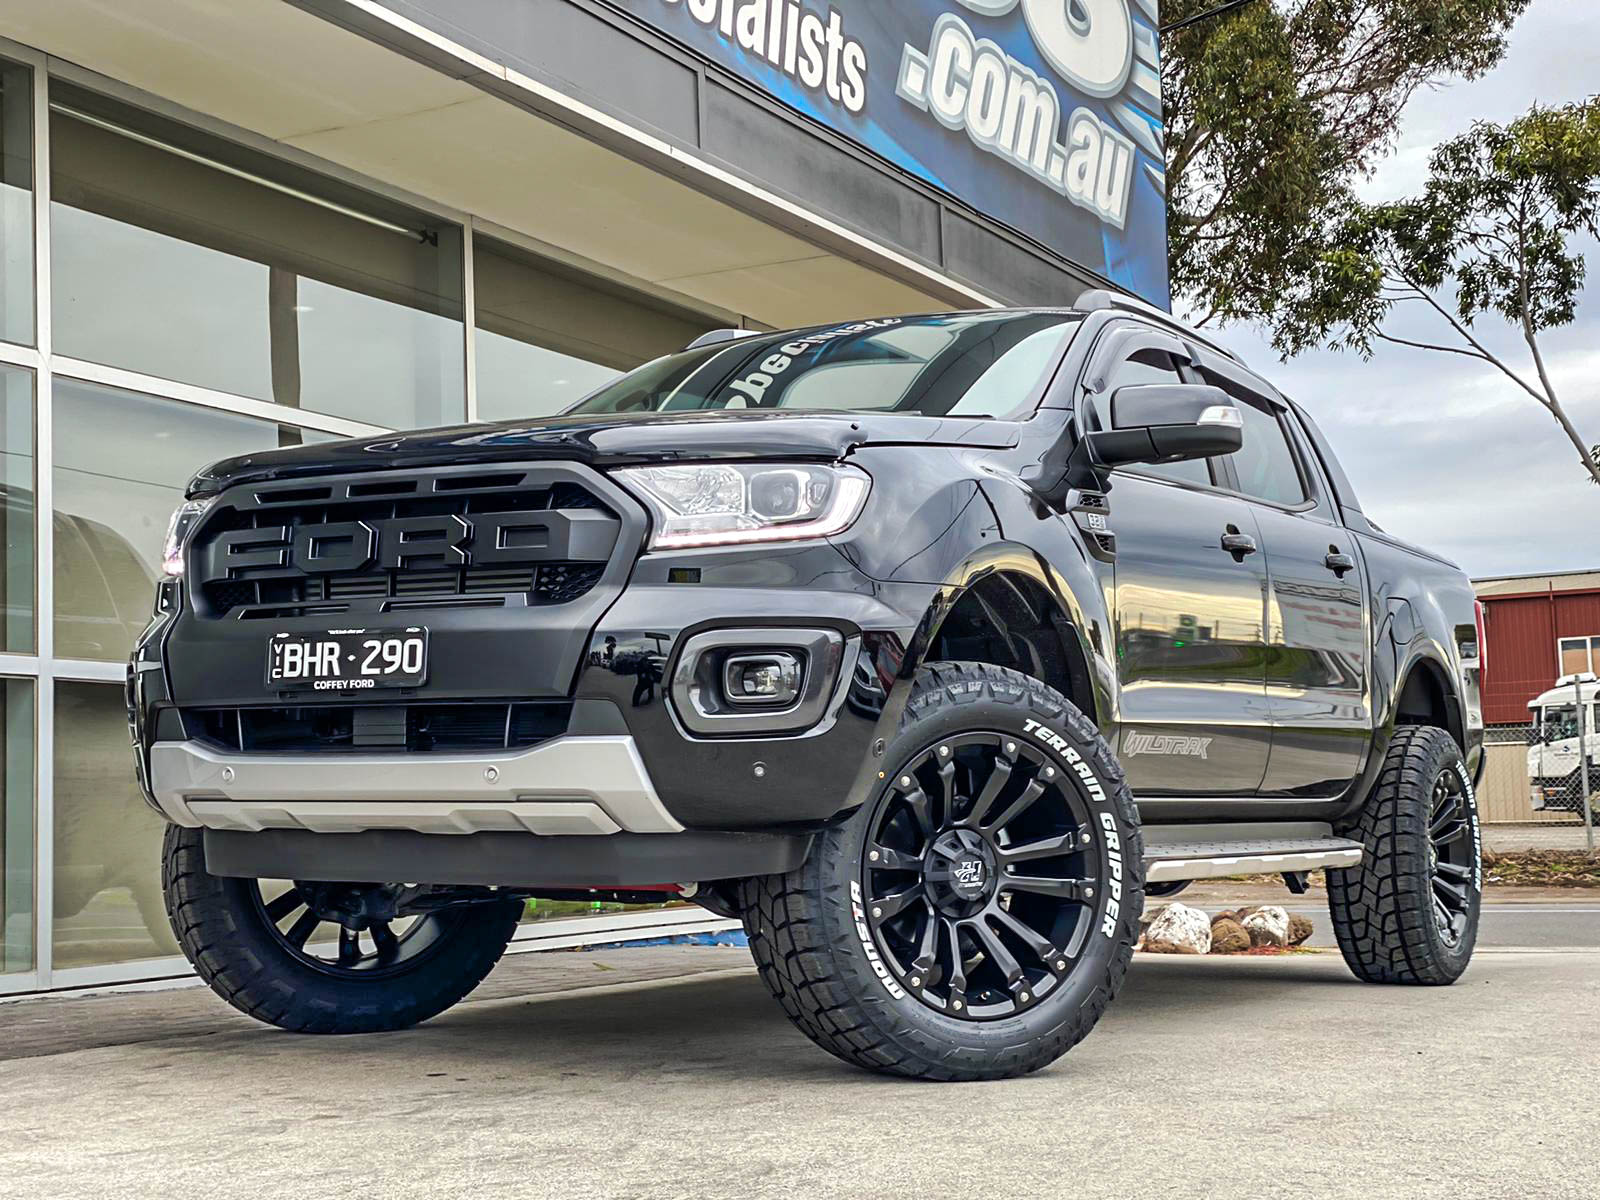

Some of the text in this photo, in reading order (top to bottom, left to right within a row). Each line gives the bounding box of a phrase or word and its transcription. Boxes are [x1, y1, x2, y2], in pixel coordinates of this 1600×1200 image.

[898, 18, 1133, 227] .com.au
[203, 508, 572, 584] FORD
[271, 643, 284, 679] VIC
[283, 638, 423, 678] BHR 290
[313, 679, 375, 690] COFFEY FORD
[1022, 718, 1123, 938] TERRAIN GRIPPER
